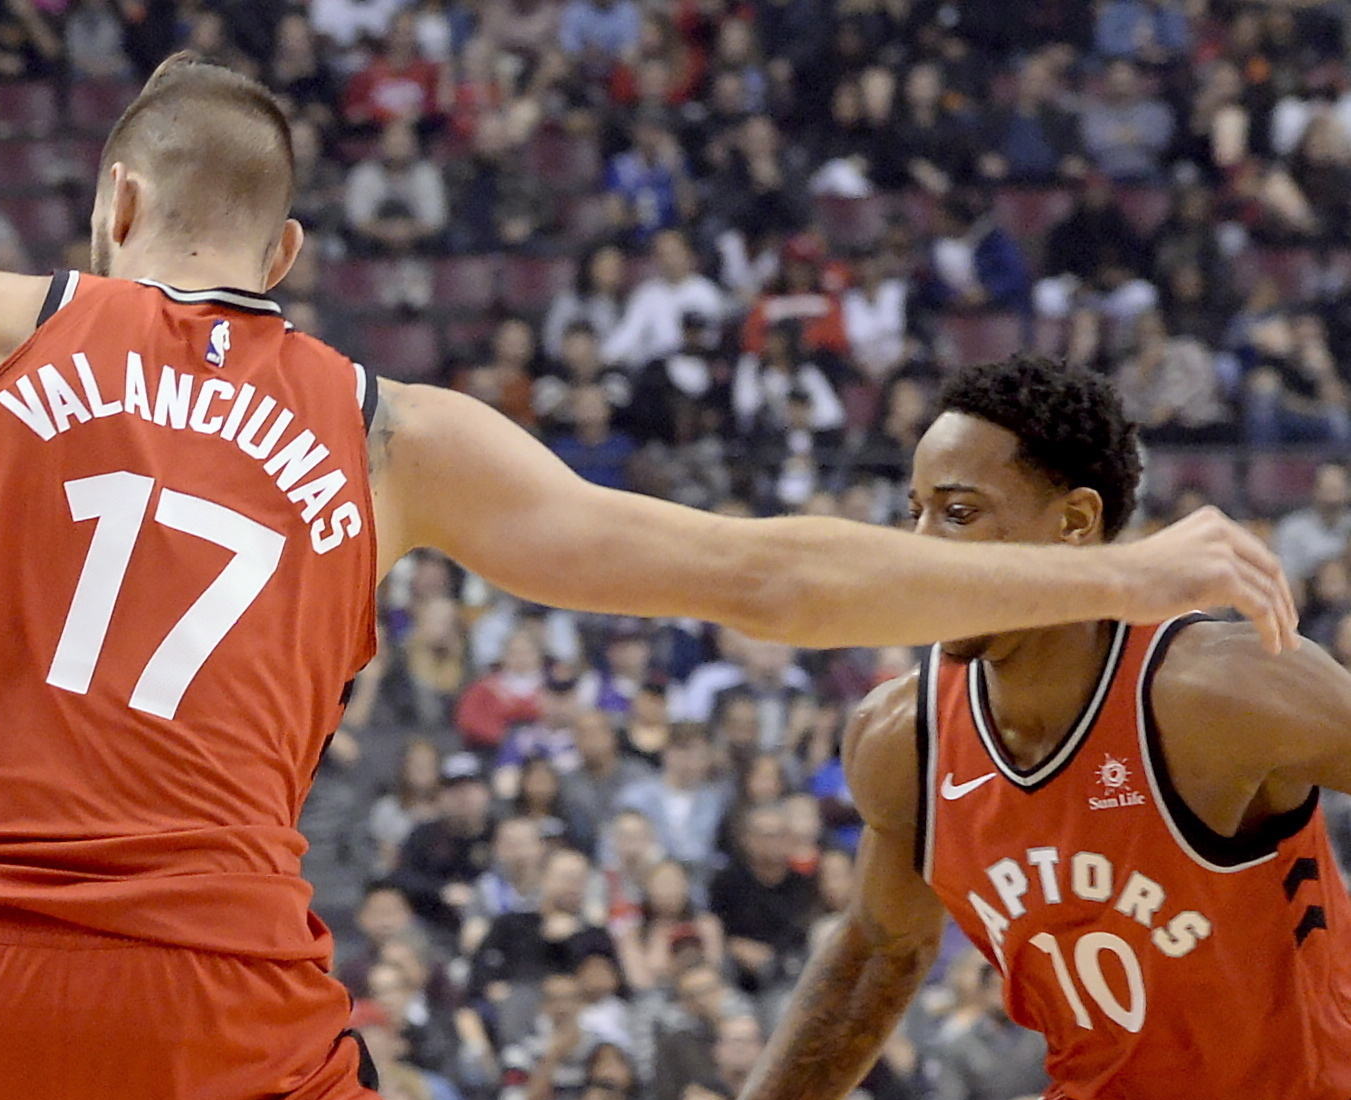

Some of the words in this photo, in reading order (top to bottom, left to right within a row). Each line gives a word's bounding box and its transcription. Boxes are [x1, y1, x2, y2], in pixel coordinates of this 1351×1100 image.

[45, 470, 287, 721] 17
[1089, 796, 1118, 810] Sun
[1118, 791, 1146, 807] Life
[967, 846, 1212, 979] APTORS
[1028, 931, 1147, 1033] 10
